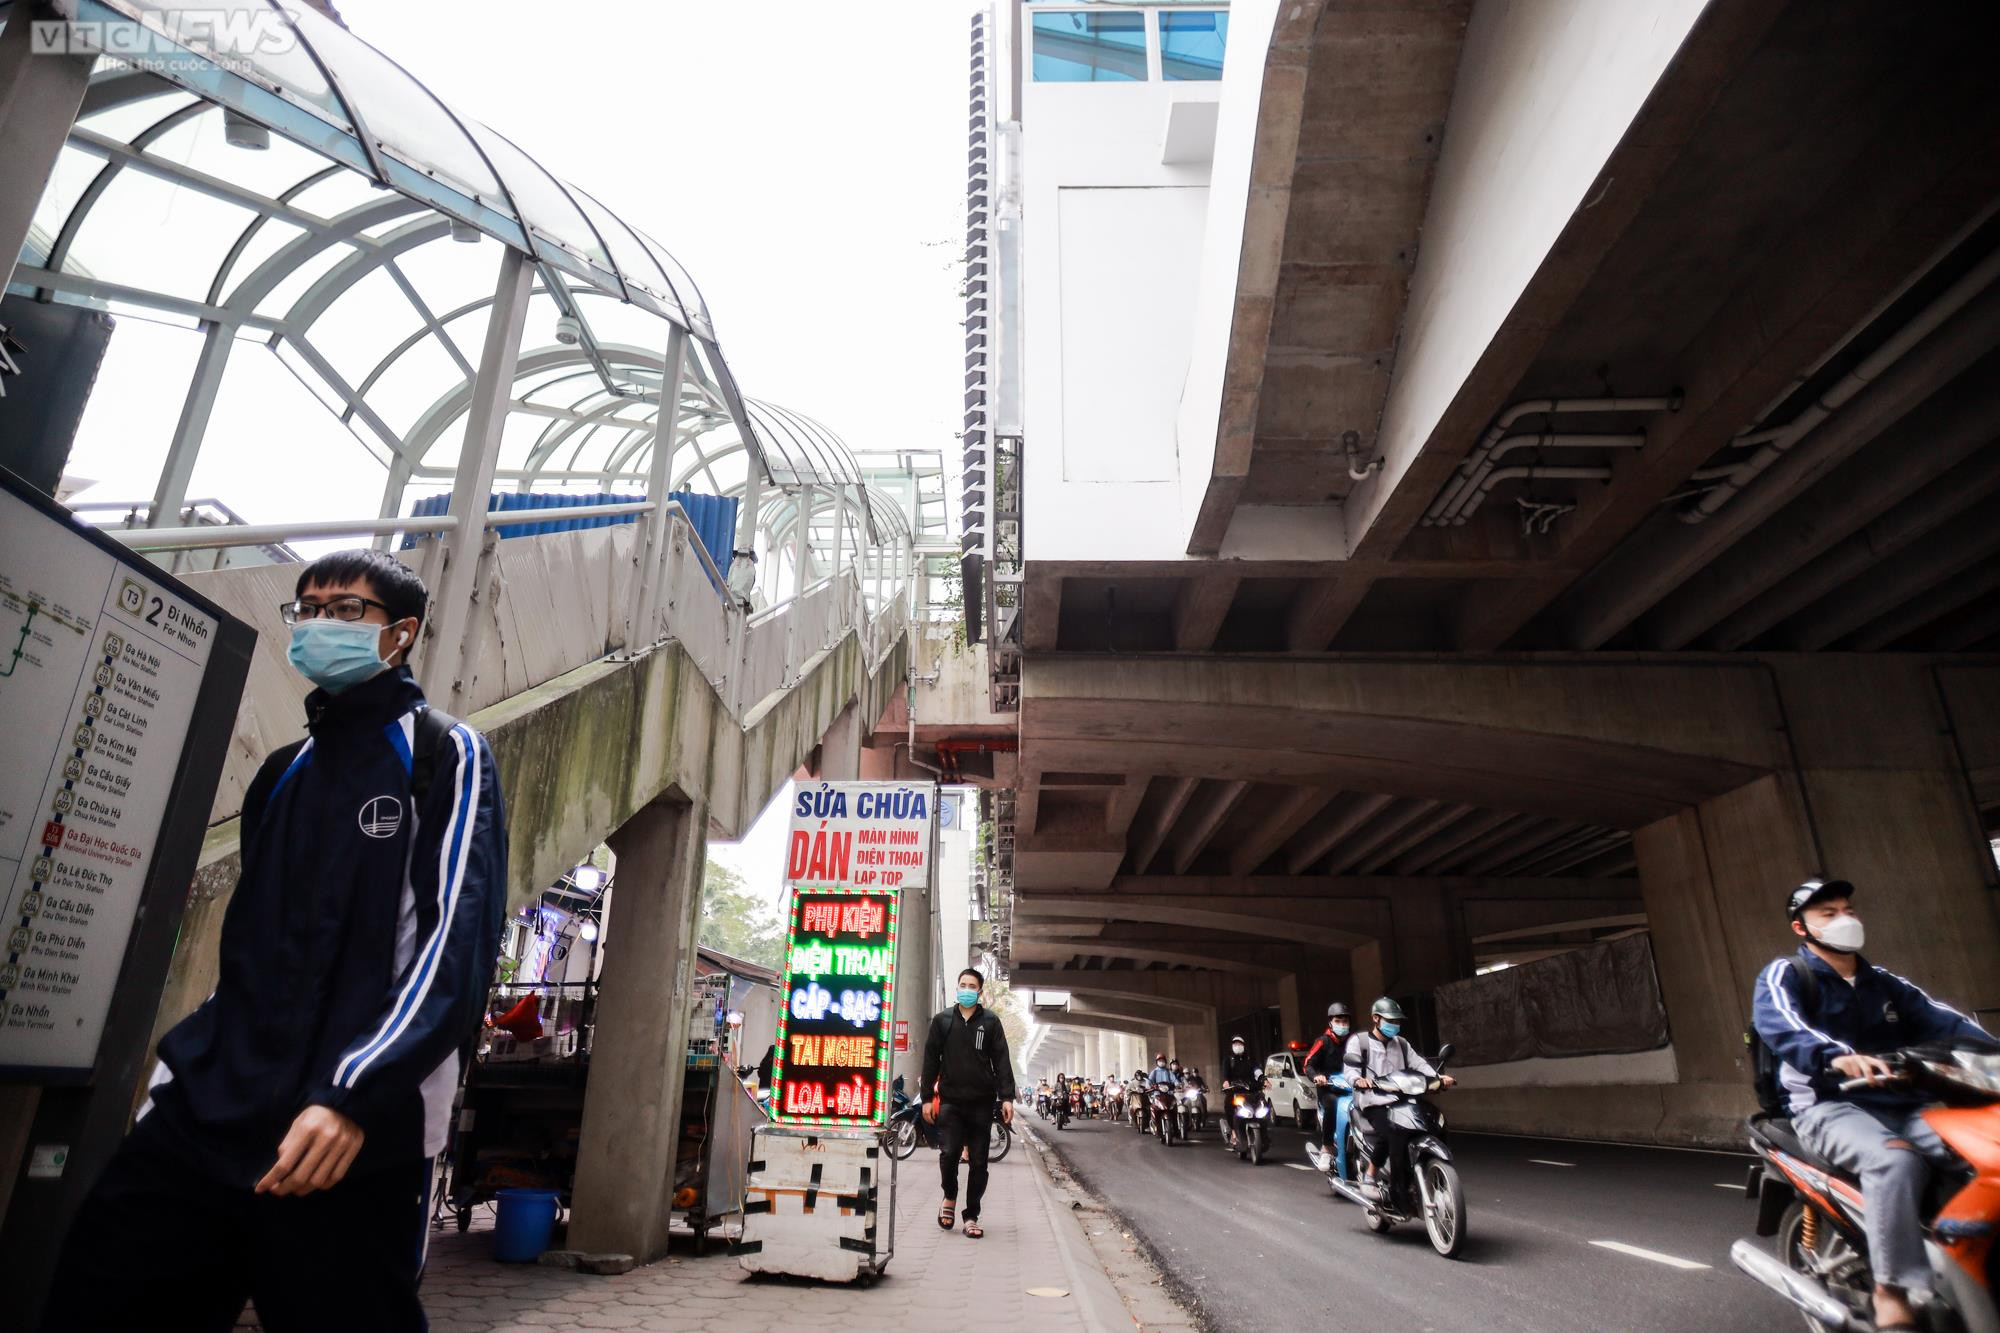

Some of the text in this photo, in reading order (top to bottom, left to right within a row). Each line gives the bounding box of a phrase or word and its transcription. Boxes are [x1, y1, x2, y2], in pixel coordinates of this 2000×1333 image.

[127, 589, 139, 605] T3
[146, 597, 163, 627] 2
[168, 606, 208, 639] Đi Nhổn
[163, 623, 197, 648] For Nhon
[126, 644, 136, 655] Ga
[117, 673, 126, 685] Ga
[114, 685, 123, 694] Van
[108, 703, 118, 714] Ga
[132, 714, 148, 729] Linh
[98, 734, 108, 745] Ga
[109, 738, 124, 751] Kim
[106, 751, 114, 759] Ma
[88, 765, 98, 776] Ga
[108, 786, 126, 798] Station
[78, 797, 88, 808] Ga
[796, 783, 927, 819] SỬA CHỮA
[98, 818, 116, 828] Station
[68, 829, 78, 840] Ga
[130, 848, 142, 859] Gia
[858, 828, 919, 845] MÀN HÌNH
[788, 821, 852, 880] DÁN
[857, 848, 923, 869] ĐIỆN THOẠI
[57, 863, 68, 874] Ga
[855, 871, 903, 886] LAP TOP
[47, 897, 58, 908] Ga
[804, 900, 883, 938] PHỤ KIỆN
[36, 931, 47, 943] Ga
[792, 941, 888, 982] ĐIỆN THOẠI
[24, 968, 80, 984] Ga Minh Khai
[12, 1004, 24, 1016] Ga
[792, 1038, 873, 1068] TAI NGHE
